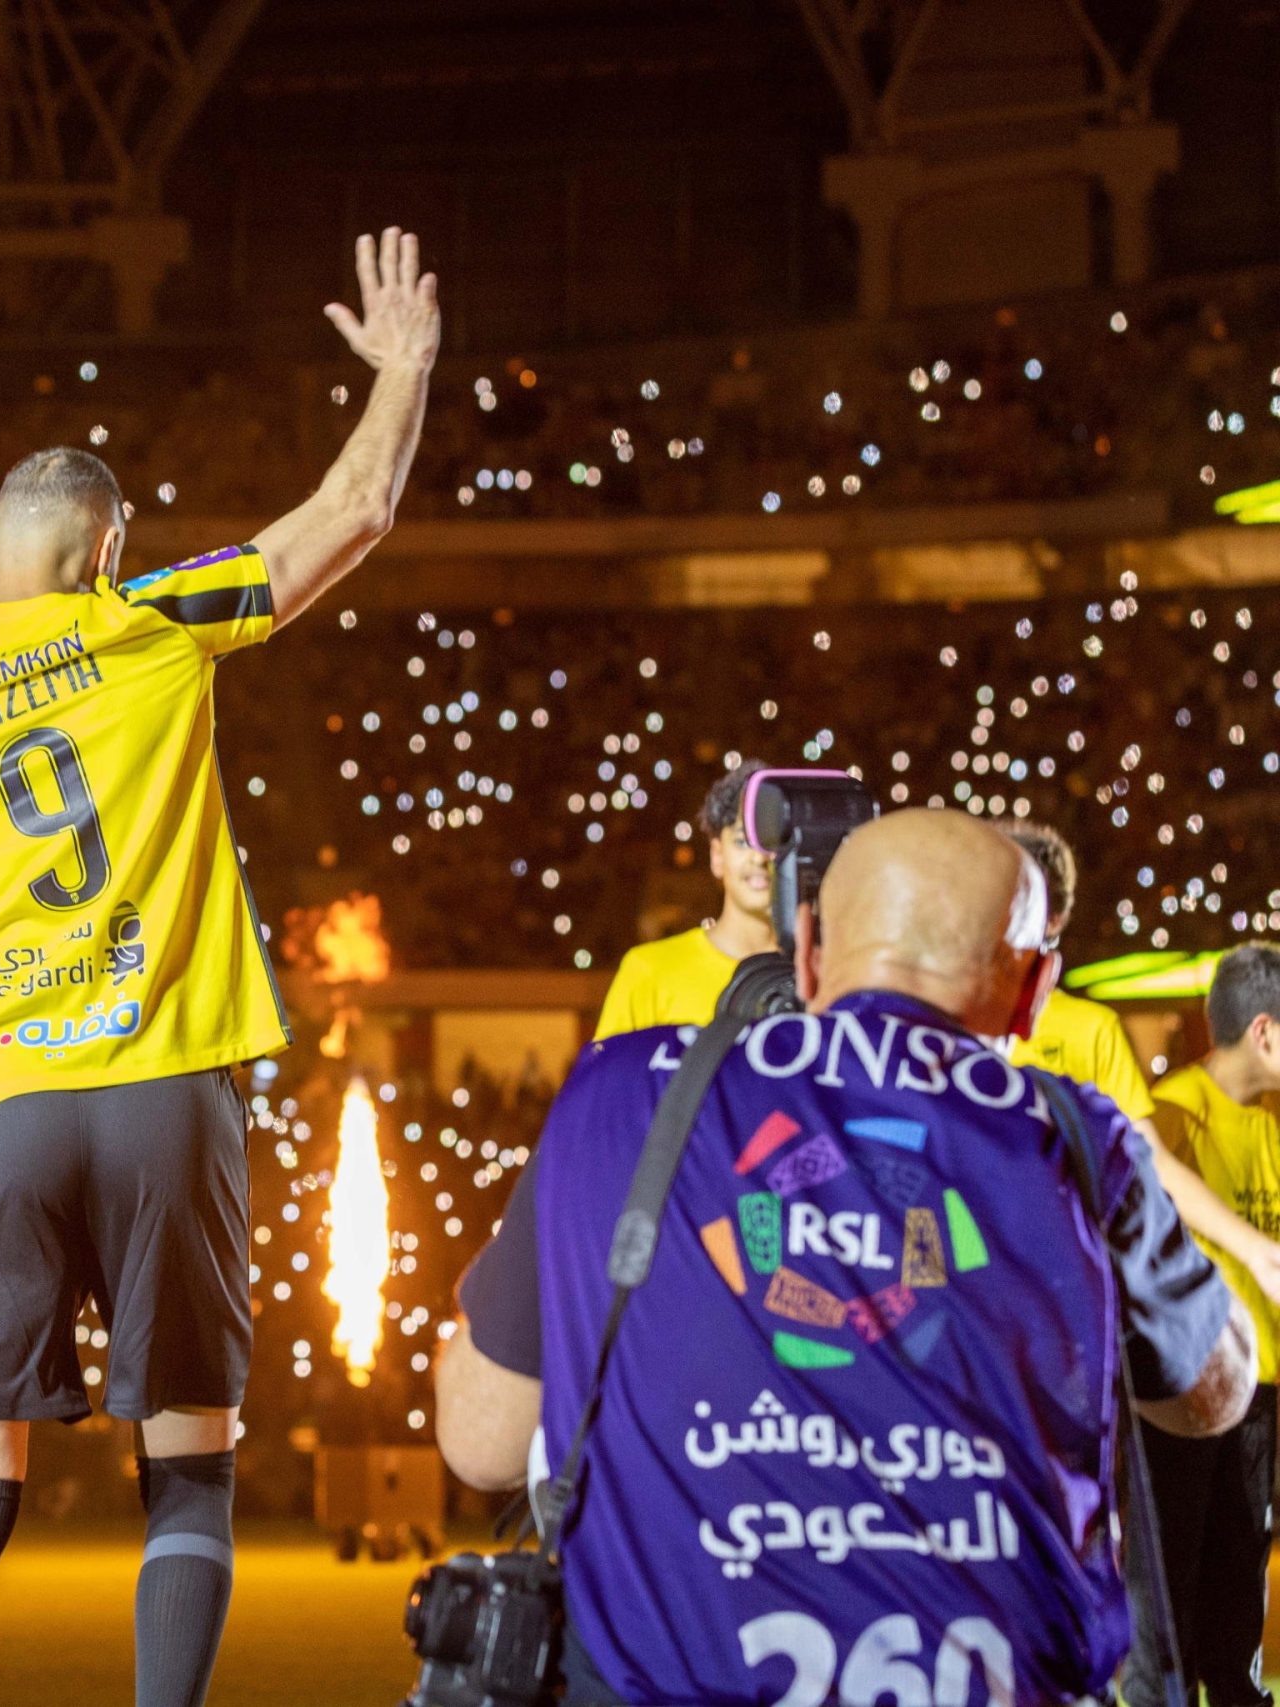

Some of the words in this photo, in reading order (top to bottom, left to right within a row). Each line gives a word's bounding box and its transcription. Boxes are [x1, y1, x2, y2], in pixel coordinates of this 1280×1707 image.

[16, 992, 142, 1059] فقيه
[788, 1201, 895, 1271] RSL
[684, 1388, 860, 1470] روشن
[860, 1423, 1006, 1495] دوري
[698, 1490, 1020, 1580] السعودي
[737, 1610, 1017, 1707] 260
